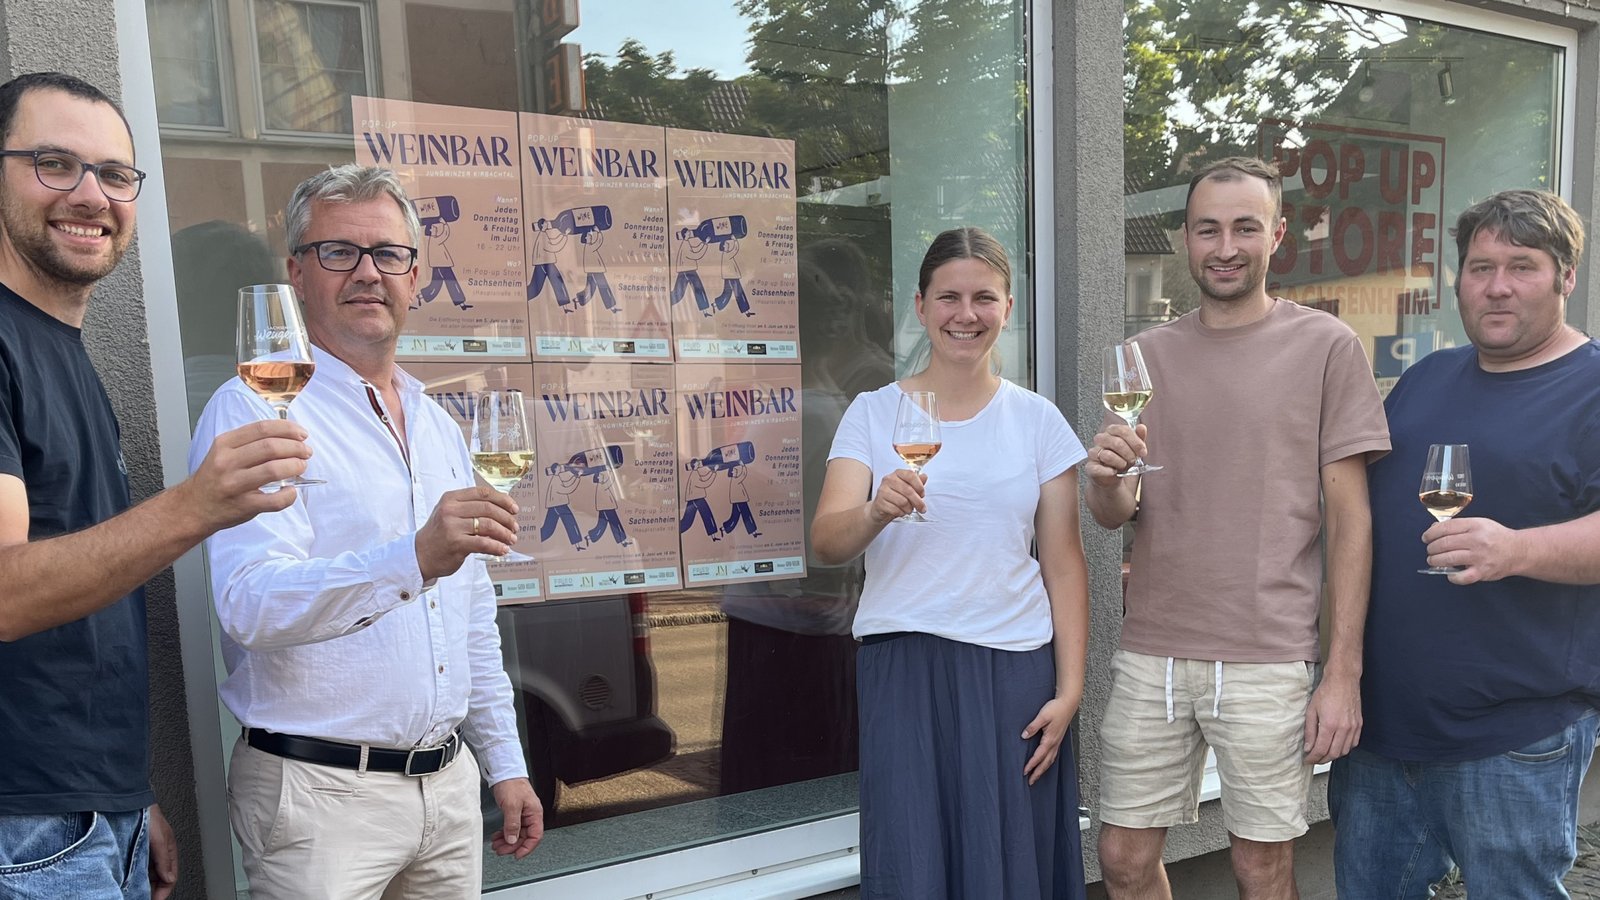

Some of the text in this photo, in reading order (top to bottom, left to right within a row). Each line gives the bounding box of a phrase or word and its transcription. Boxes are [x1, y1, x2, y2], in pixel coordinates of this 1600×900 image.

[361, 119, 398, 129] POP-UP
[527, 134, 560, 143] POP-UP
[363, 132, 513, 167] WEINBAR
[528, 146, 660, 178] WEINBAR
[425, 169, 471, 177] JUNGWINZER
[673, 159, 790, 189] WEINBAR
[1272, 136, 1436, 205] POP UP
[496, 195, 518, 204] Wann?
[494, 206, 518, 214] Jeden
[473, 214, 519, 225] Donnerstag
[642, 215, 664, 223] Jeden
[491, 224, 519, 234] Freitag
[624, 222, 664, 233] Donnerstag
[639, 233, 665, 241] Freitag
[758, 231, 794, 241] Donnerstag
[1270, 201, 1436, 279] STORE
[507, 244, 520, 252] Uhr
[771, 241, 794, 249] Freitag
[506, 260, 522, 268] Wo?
[474, 268, 500, 277] Pop-up
[468, 278, 522, 287] Sachsenheim
[618, 283, 666, 292] Sachsenheim
[751, 288, 795, 297] Sachsenheim
[541, 382, 572, 391] POP-UP
[542, 388, 670, 422] WEINBAR
[683, 387, 796, 420] WEINBAR
[765, 454, 800, 462] Donnerstag
[634, 459, 674, 467] Donnerstag
[778, 462, 800, 470] Freitag
[649, 467, 674, 475] Freitag
[659, 475, 674, 483] Juni
[759, 509, 800, 517] Sachsenheim
[628, 516, 675, 525] Sachsenheim
